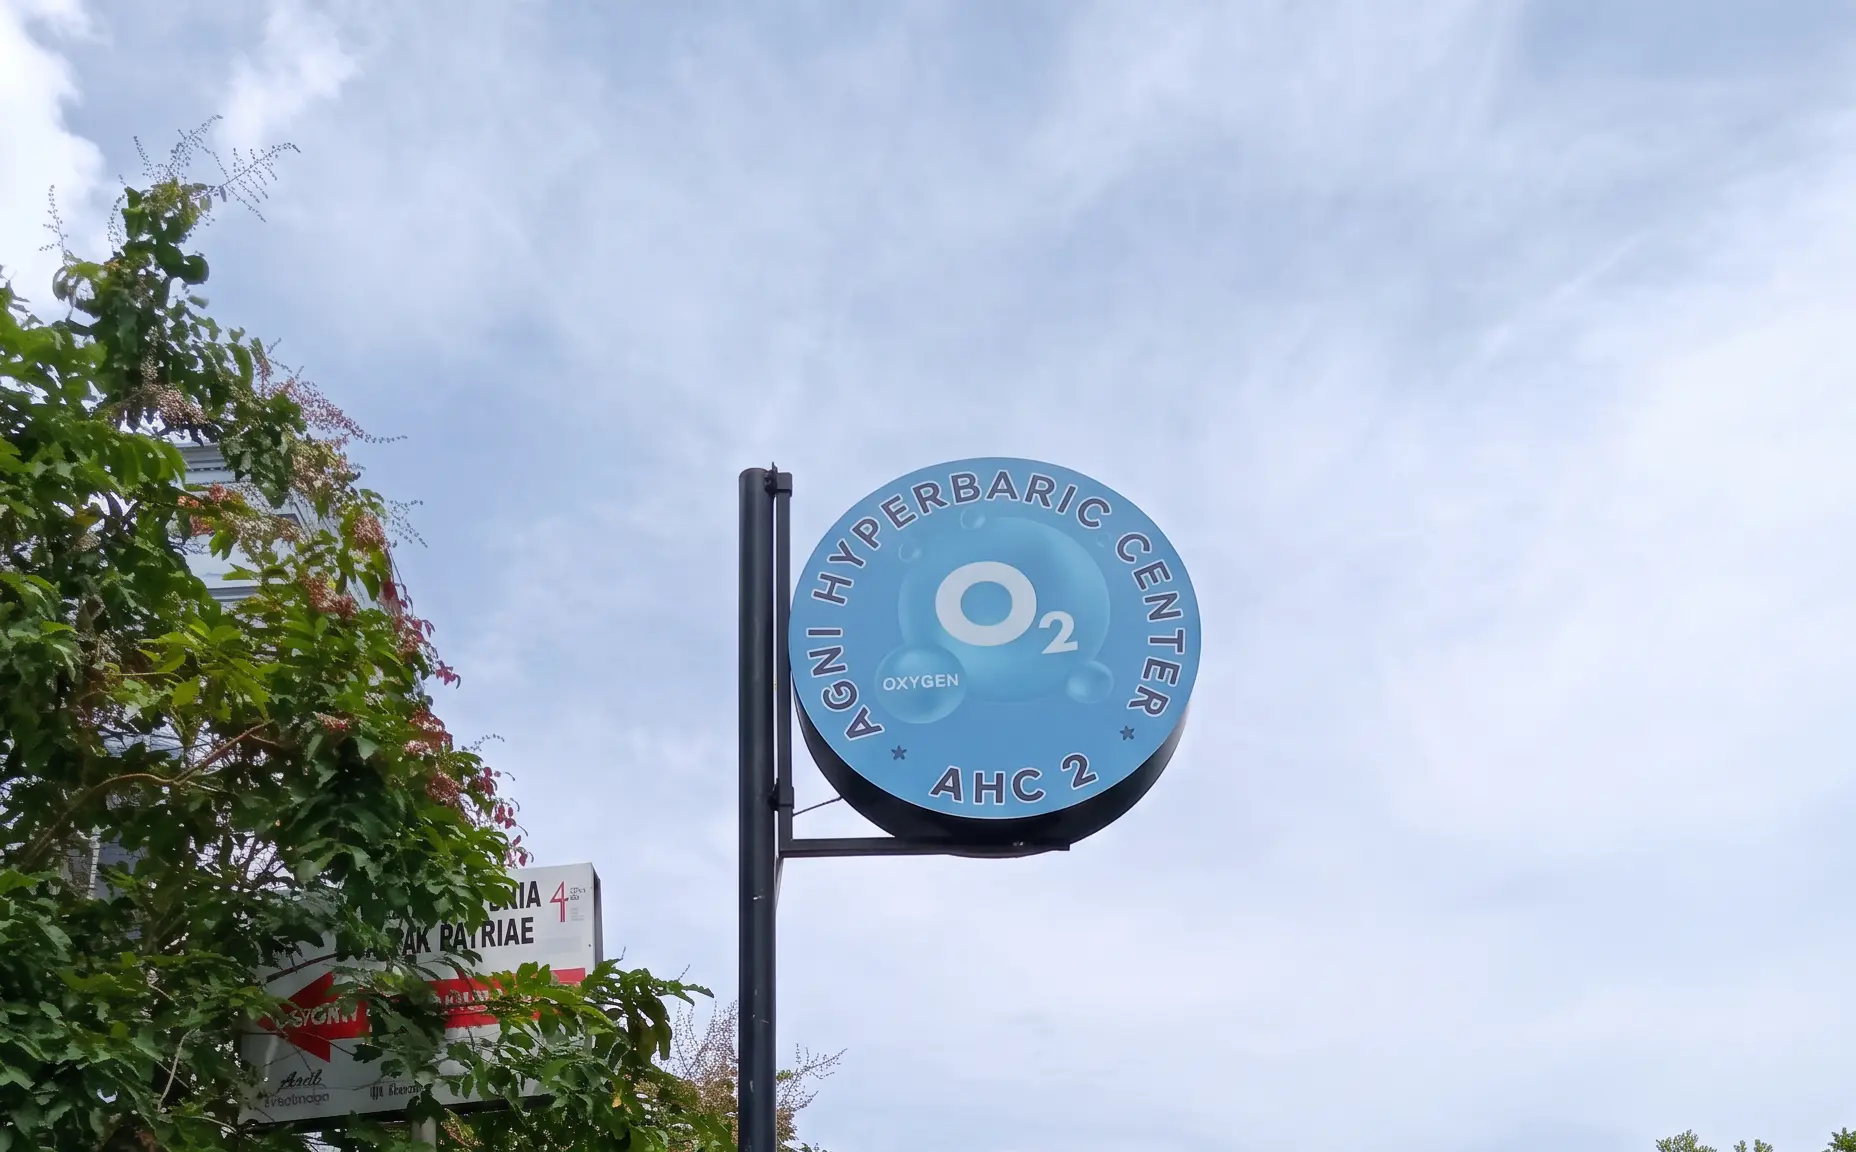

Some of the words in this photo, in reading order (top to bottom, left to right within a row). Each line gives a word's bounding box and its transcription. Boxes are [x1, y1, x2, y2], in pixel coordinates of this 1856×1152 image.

[812, 470, 1112, 605] HYPERBARIC
[1116, 533, 1185, 717] CENTER
[807, 627, 884, 740] AGNI
[883, 673, 959, 691] OXYGEN
[930, 767, 1045, 804] AHC
[1062, 752, 1098, 791] 2
